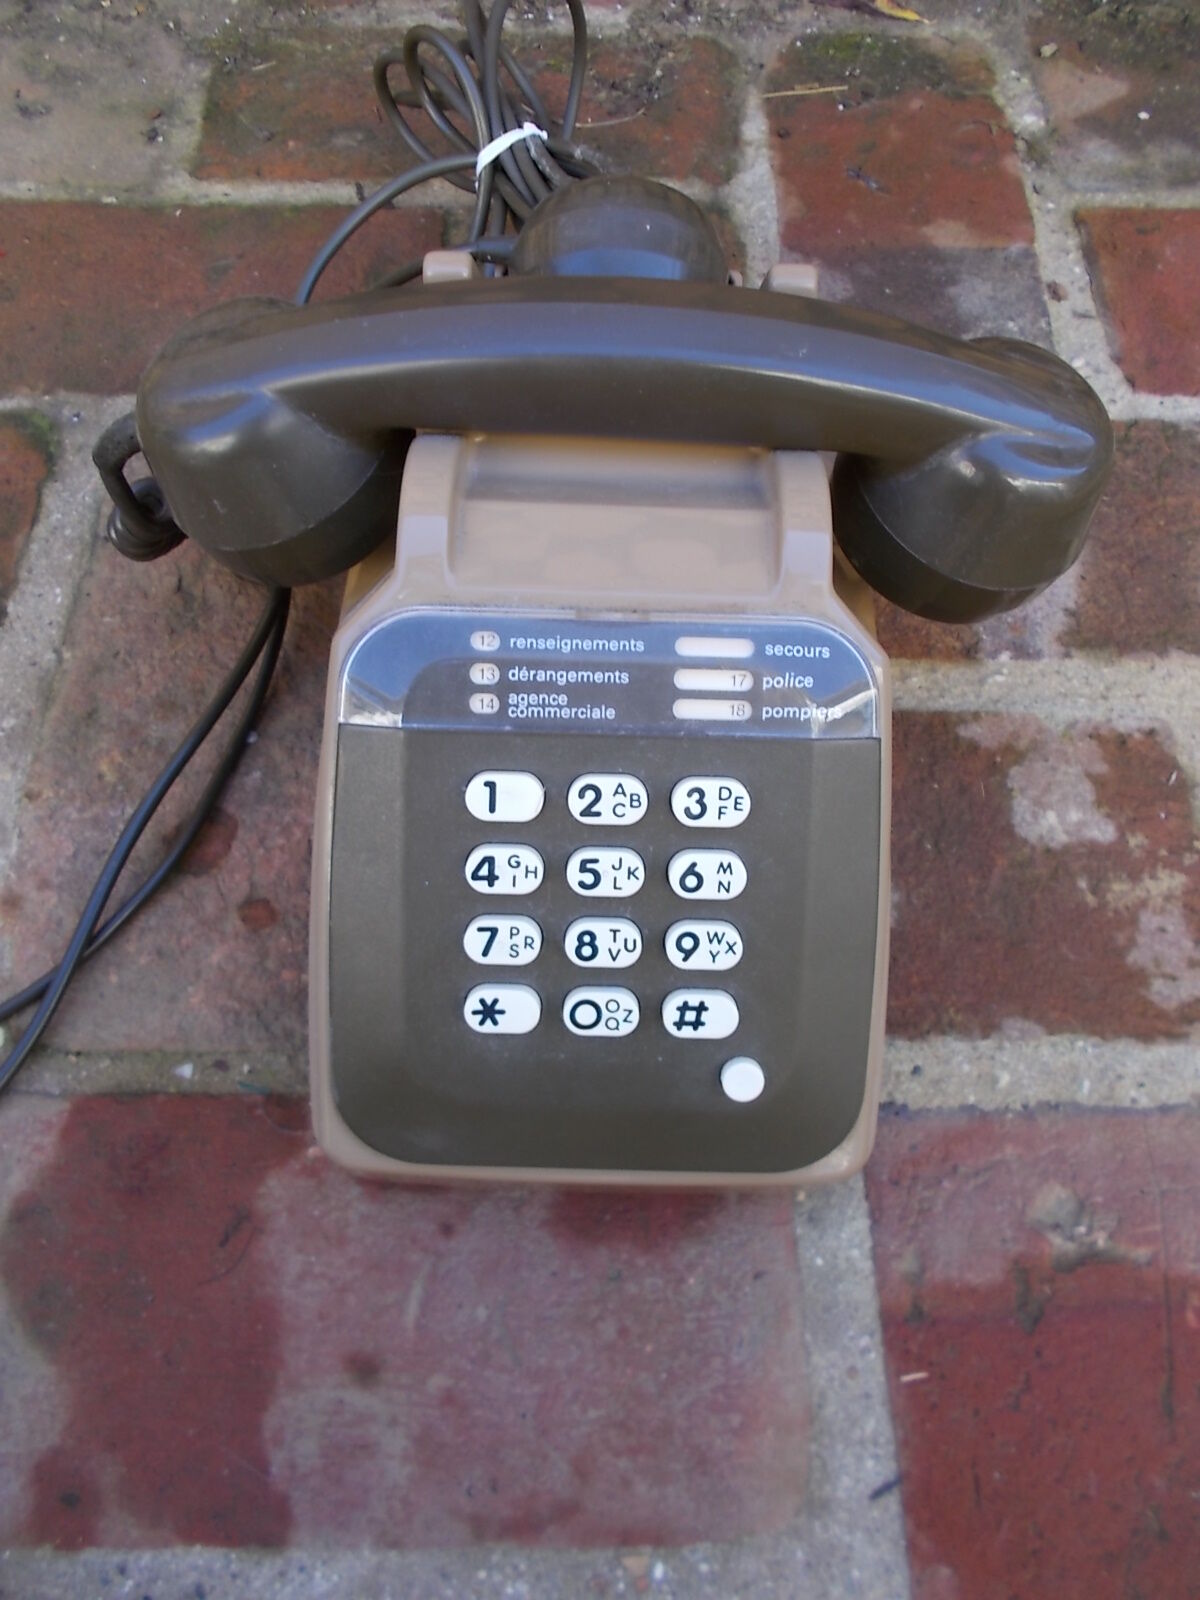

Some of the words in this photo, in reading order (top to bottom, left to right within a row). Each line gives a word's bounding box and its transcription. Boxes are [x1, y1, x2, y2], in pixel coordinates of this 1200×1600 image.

[478, 634, 496, 648] 12
[509, 635, 646, 653] renseignements
[764, 643, 831, 659] secours
[478, 667, 496, 682] 13
[508, 666, 630, 686] dérangements
[731, 674, 747, 688] 17
[762, 672, 814, 691] police
[479, 697, 495, 711] 14
[508, 704, 616, 720] commerciale
[508, 692, 569, 709] agence
[730, 703, 746, 717] 18
[484, 781, 496, 813] 1
[578, 783, 602, 817] 2
[684, 786, 708, 821] 3
[471, 855, 500, 888] 4
[577, 858, 602, 891] 5
[679, 861, 704, 894] 6
[476, 926, 499, 958] 7
[574, 930, 599, 962] 8
[676, 931, 701, 963] 9
